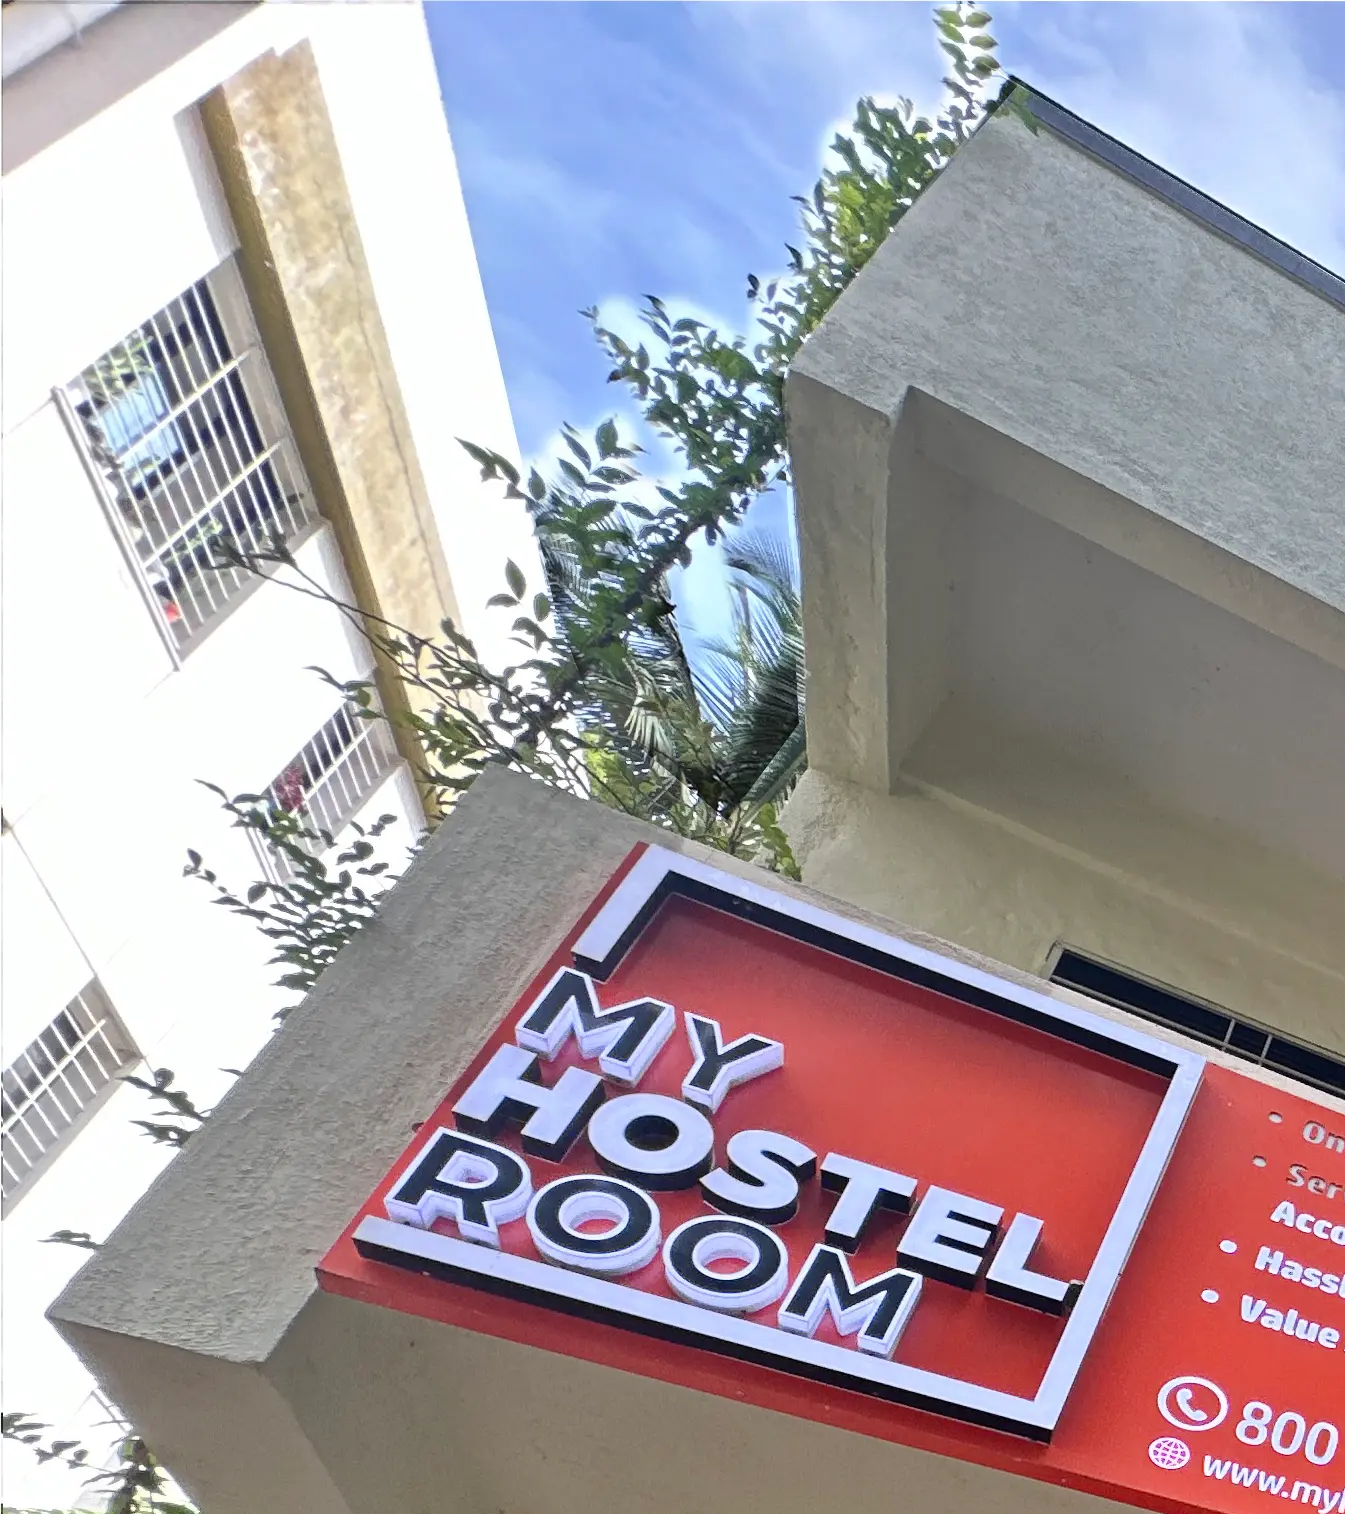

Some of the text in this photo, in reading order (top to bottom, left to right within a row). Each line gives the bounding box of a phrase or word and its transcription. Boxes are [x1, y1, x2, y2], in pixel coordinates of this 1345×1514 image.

[515, 965, 785, 1114] MY
[384, 1126, 923, 1357] ROOM
[451, 1043, 1084, 1316] HOSTEL
[1240, 1295, 1340, 1349] Value
[1235, 1401, 1339, 1466] 800
